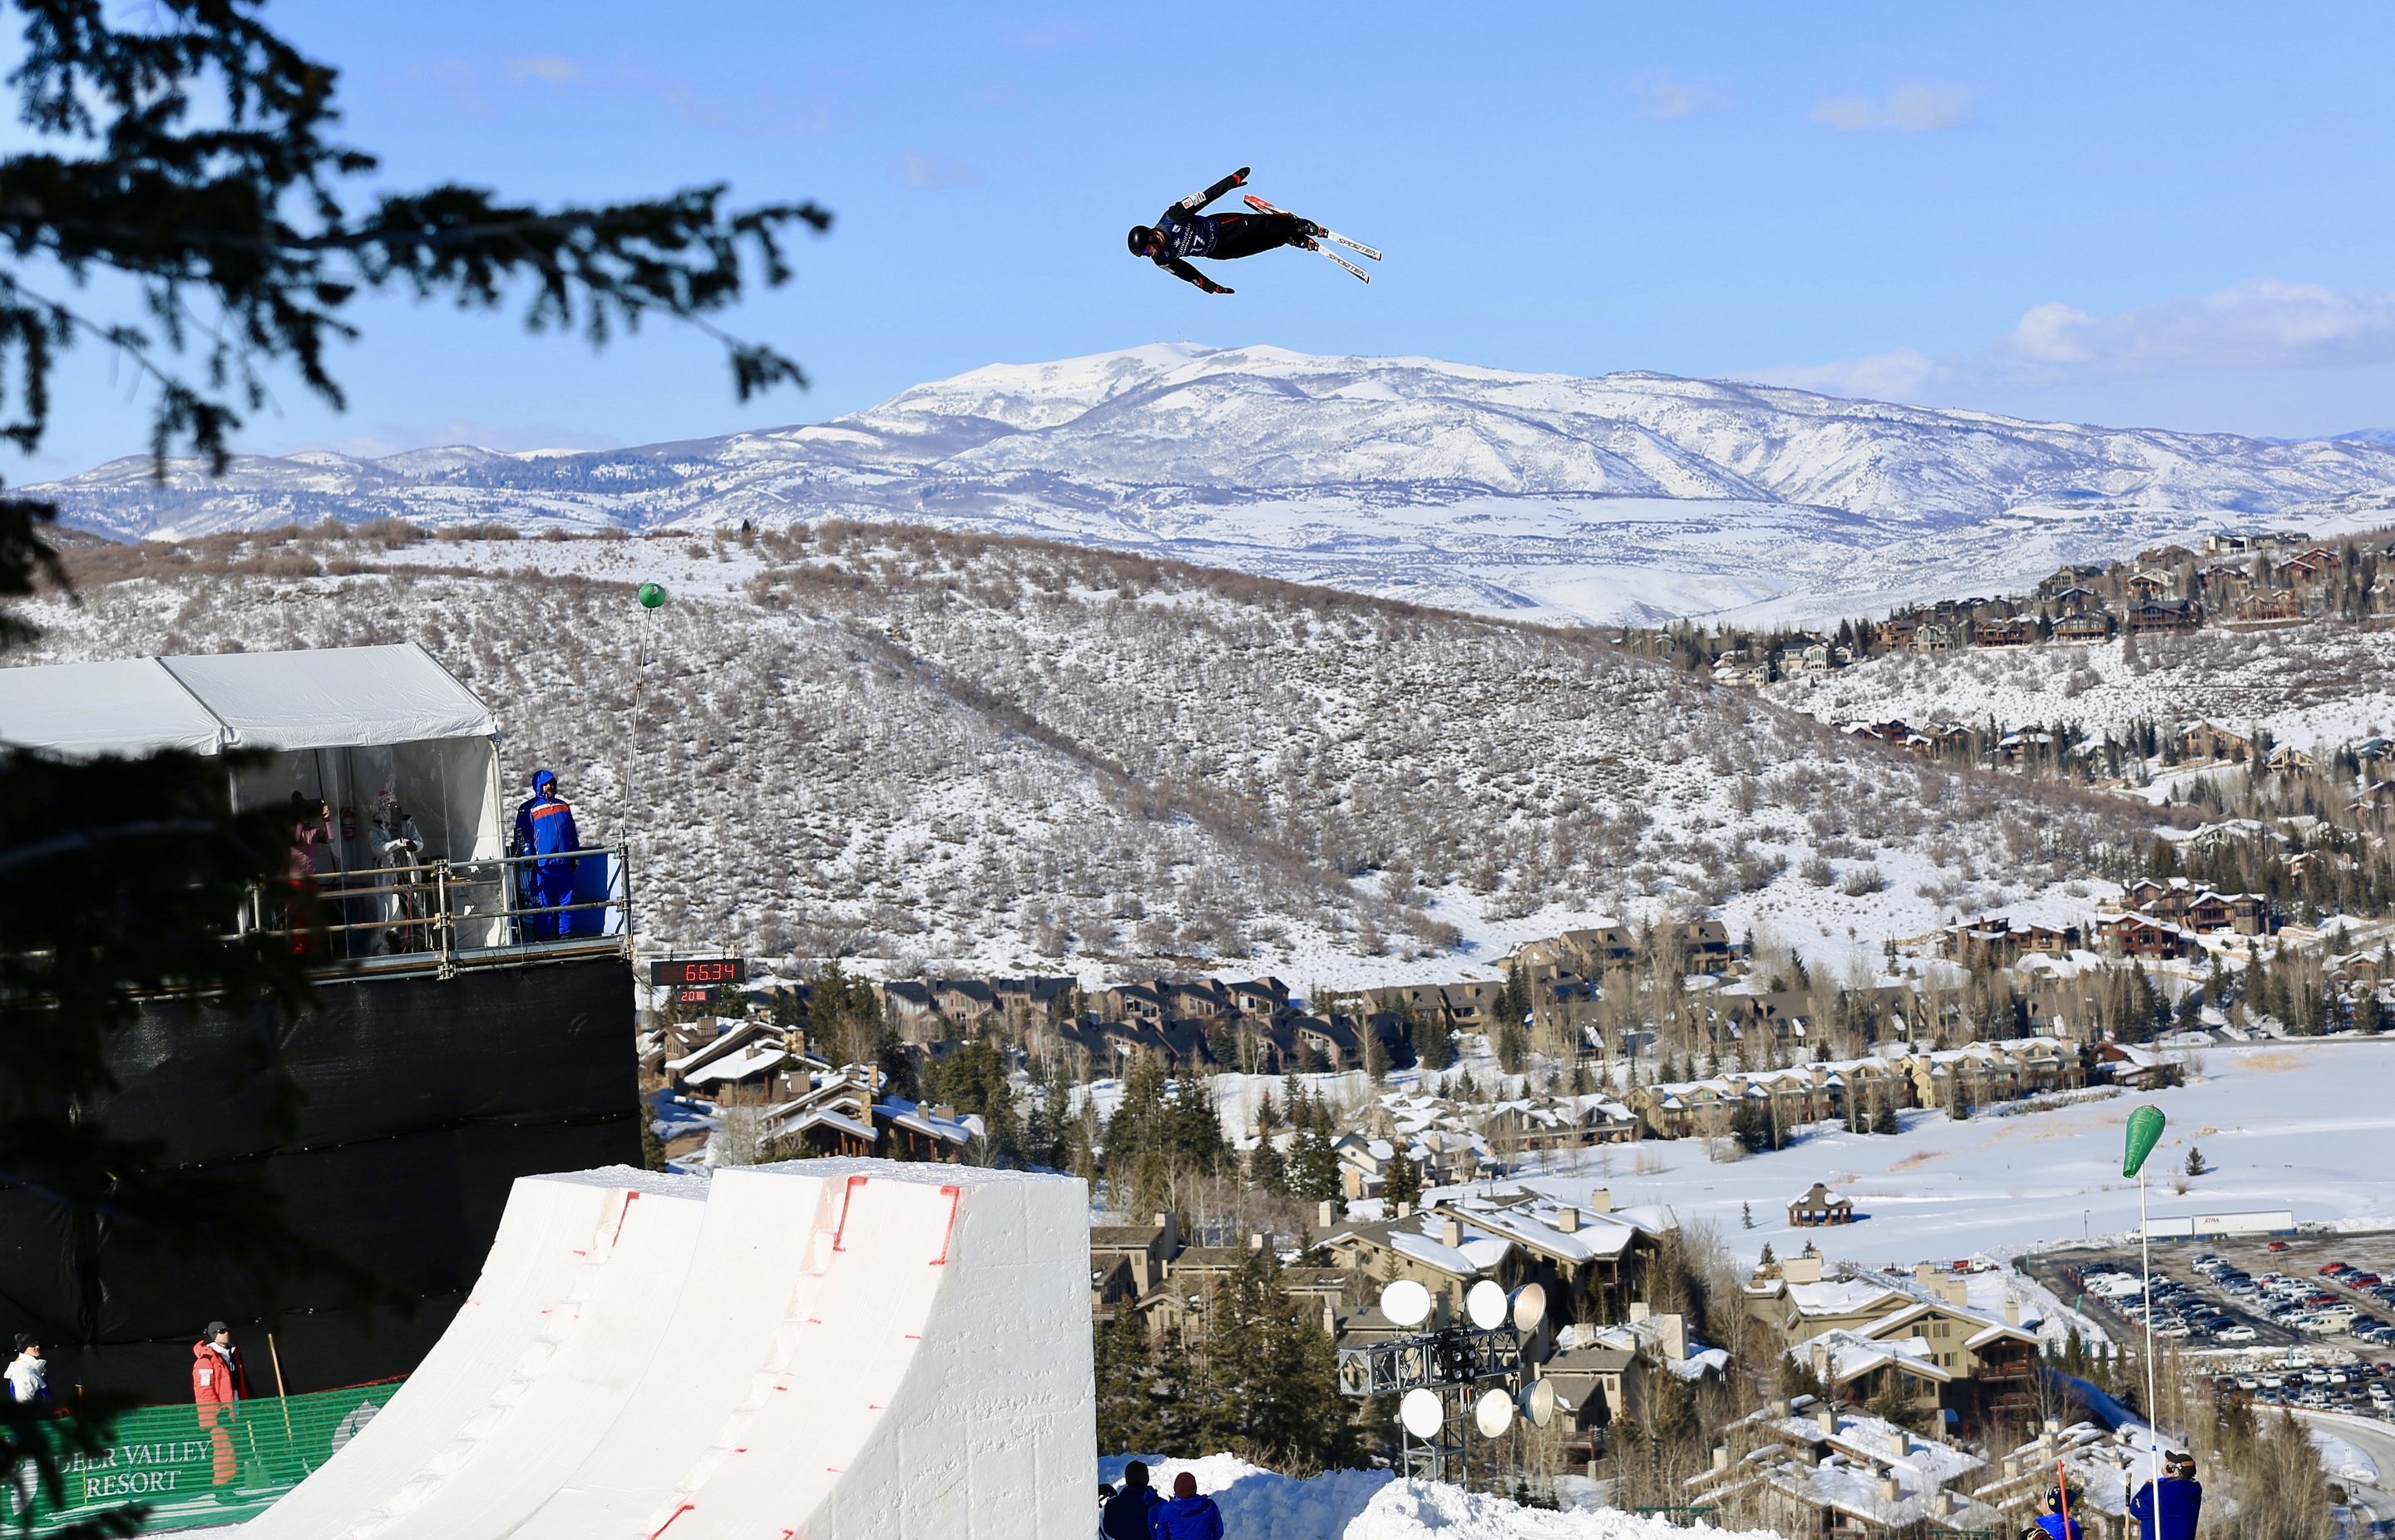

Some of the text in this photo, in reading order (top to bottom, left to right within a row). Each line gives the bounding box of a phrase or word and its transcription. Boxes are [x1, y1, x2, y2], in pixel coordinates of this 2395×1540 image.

[1190, 234, 1206, 253] 17
[1337, 238, 1377, 255] SPORTEN
[1326, 254, 1366, 277] SPORTEN
[686, 964, 734, 980] 66.34
[122, 1440, 213, 1465] VALLEY
[86, 1470, 182, 1498] RESORT
